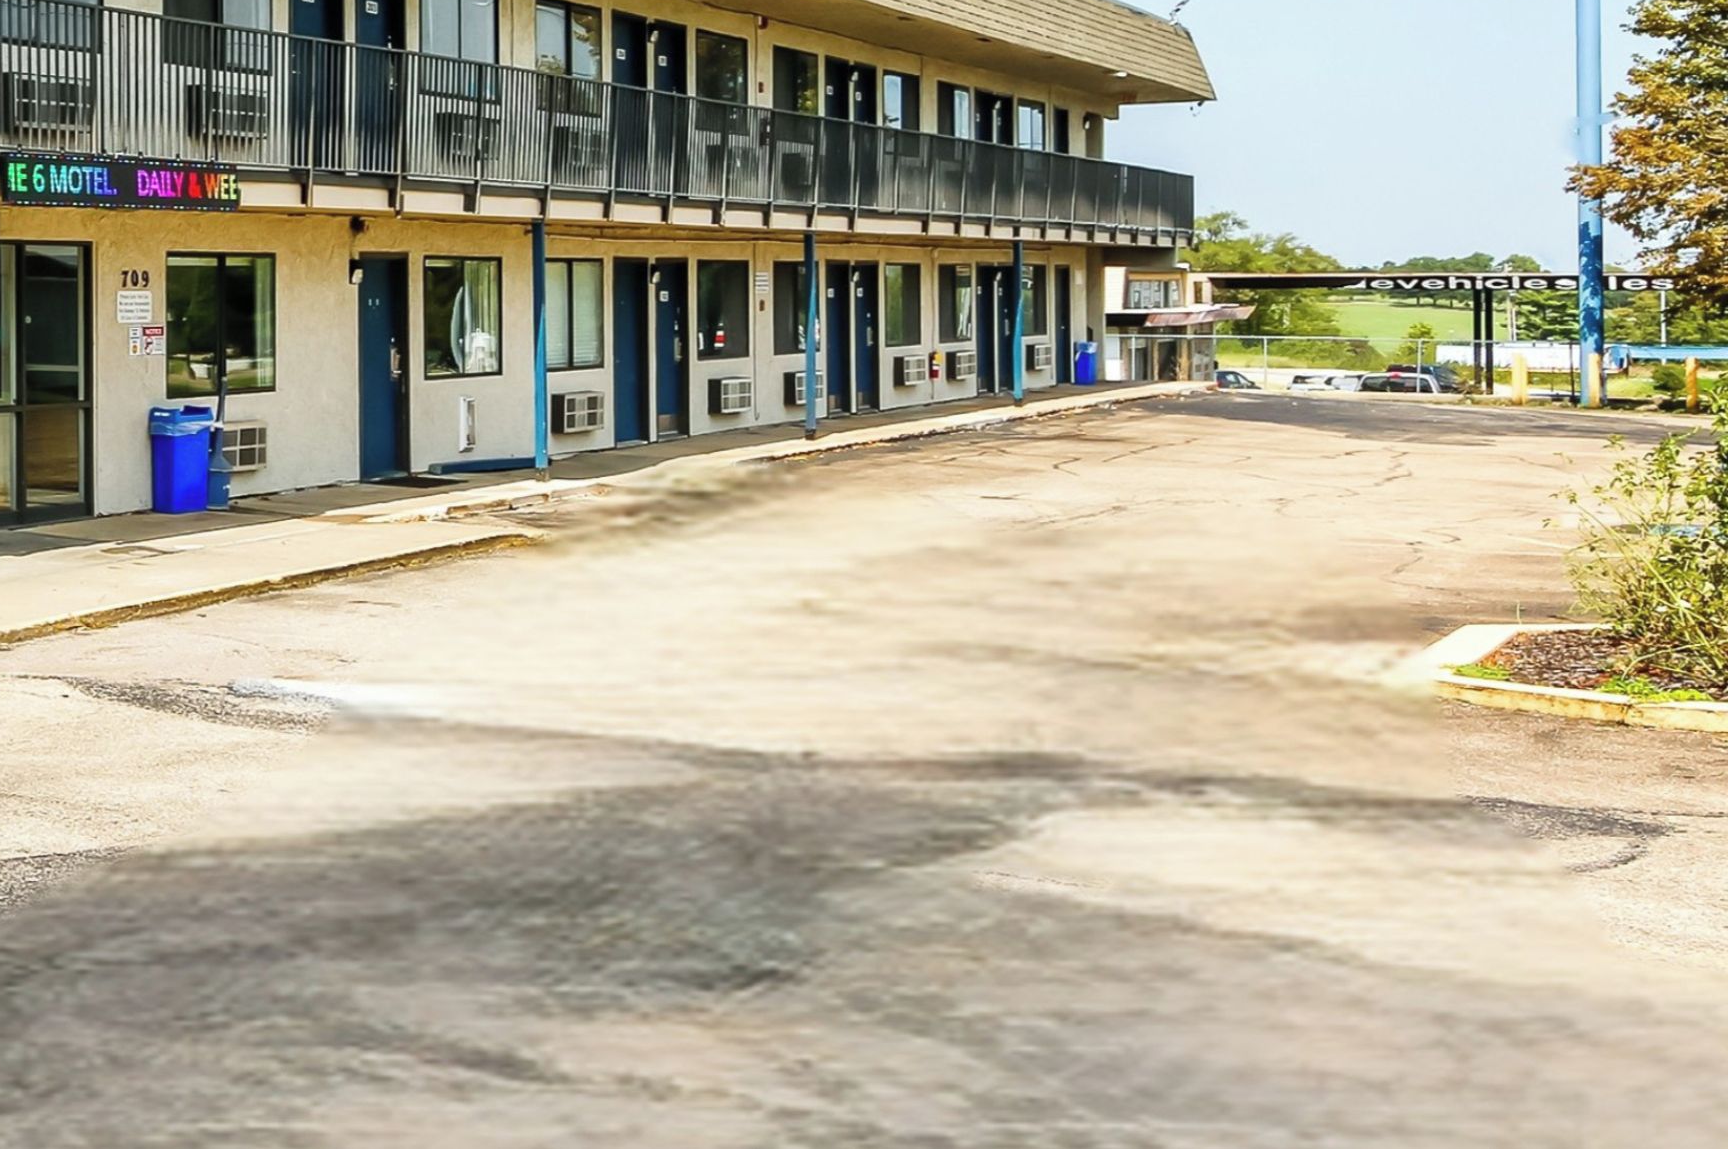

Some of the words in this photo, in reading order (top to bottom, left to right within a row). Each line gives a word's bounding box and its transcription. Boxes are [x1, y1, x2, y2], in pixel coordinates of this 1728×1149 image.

[33, 163, 45, 193] 6
[137, 169, 184, 198] DAILY
[188, 172, 202, 199] &
[120, 269, 150, 288] 709
